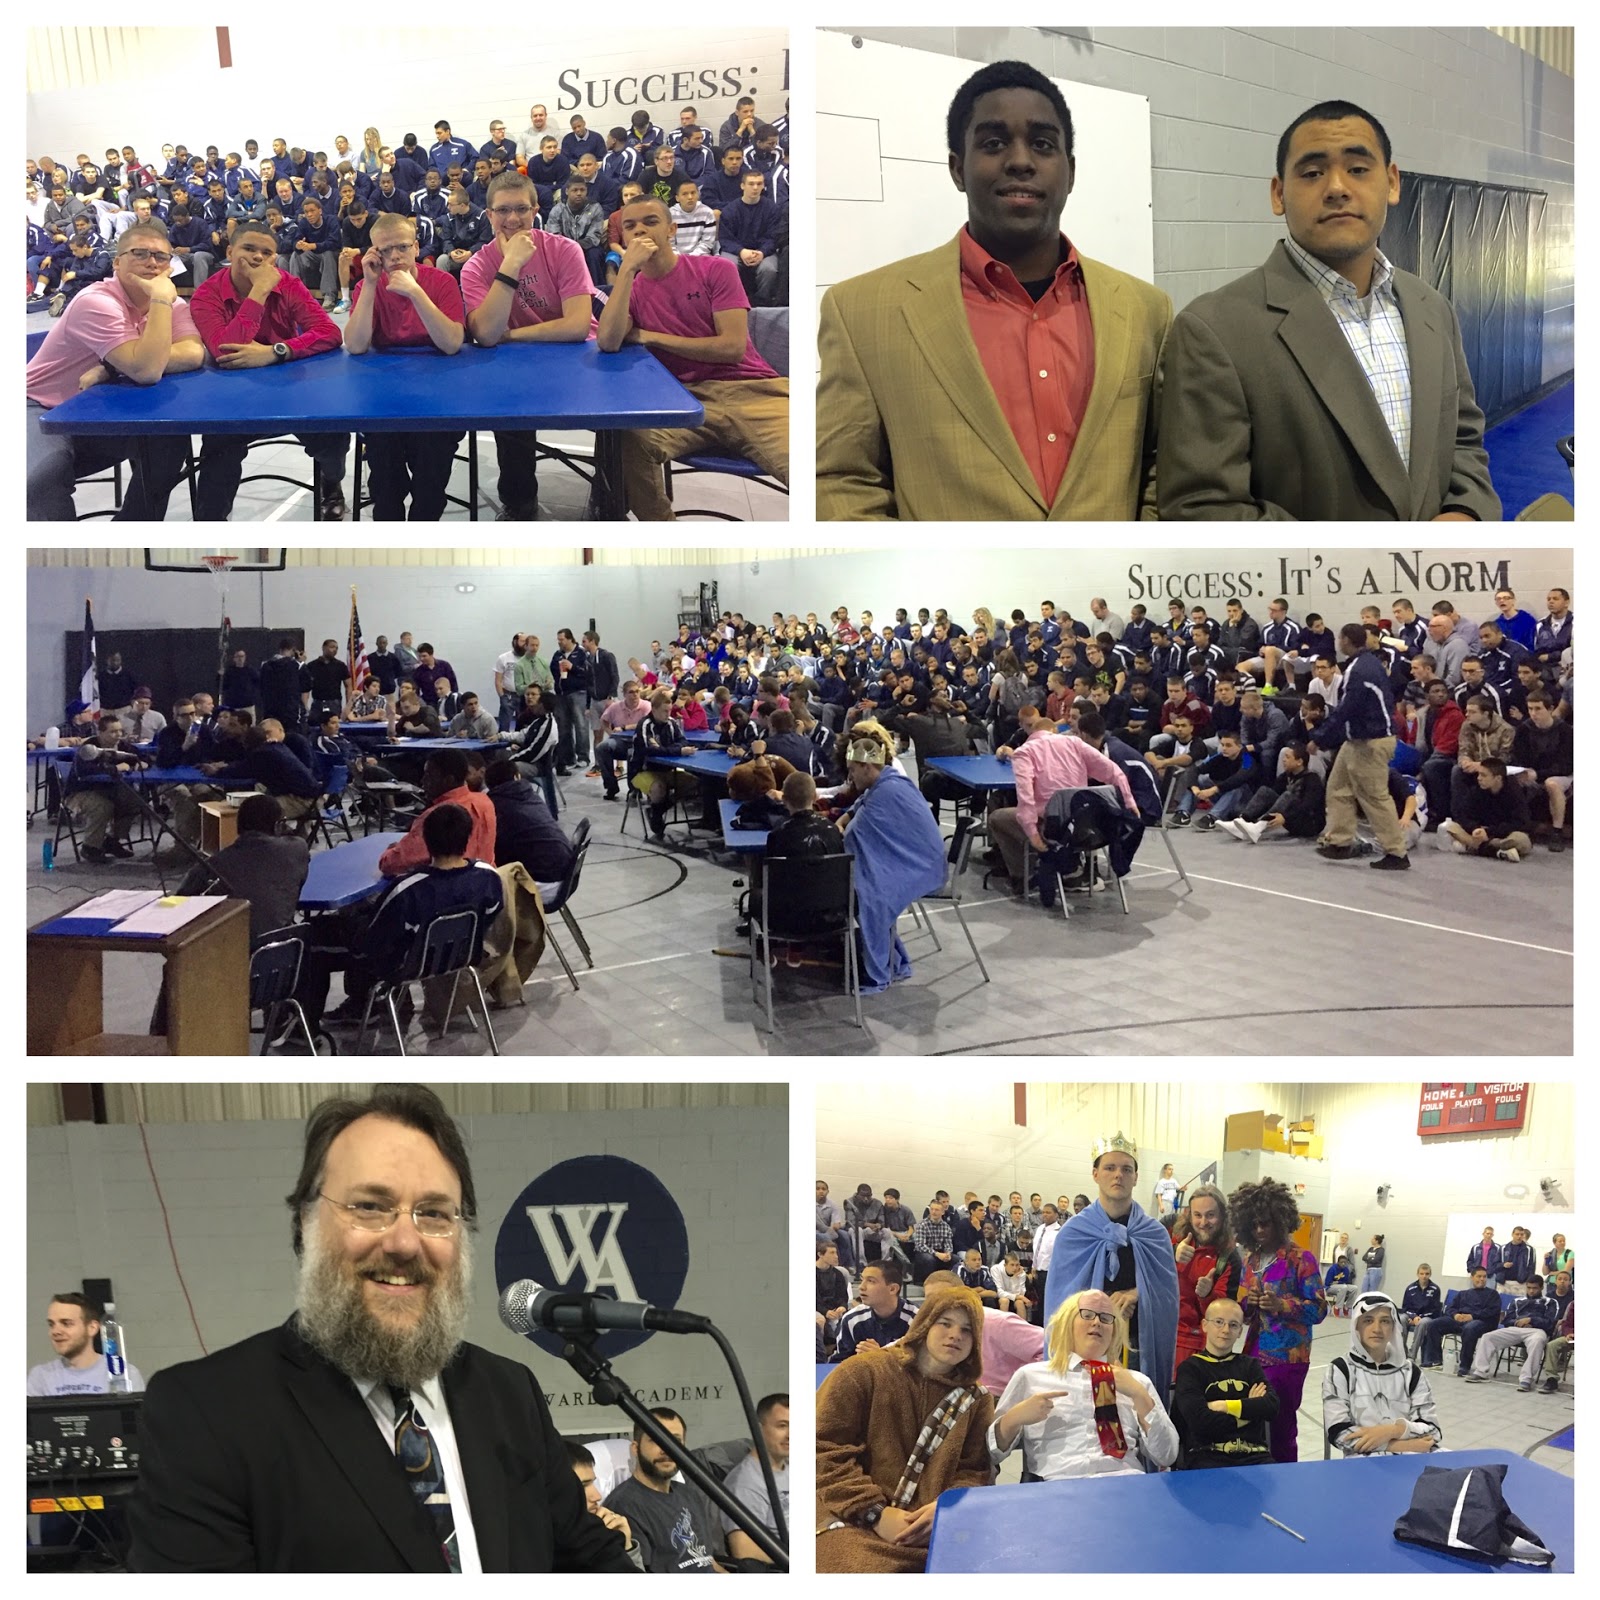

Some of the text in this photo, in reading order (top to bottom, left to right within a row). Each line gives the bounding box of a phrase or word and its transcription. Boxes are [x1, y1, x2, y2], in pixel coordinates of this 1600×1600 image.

[1356, 567, 1382, 595] A
[1388, 550, 1512, 594] NORM
[1484, 1083, 1525, 1095] VISITOR
[1423, 1089, 1456, 1102] HOME
[1495, 1094, 1521, 1104] FOULS
[1421, 1102, 1443, 1111] FOULS
[1455, 1098, 1483, 1108] PLAYER
[635, 1385, 724, 1402] CADEMY
